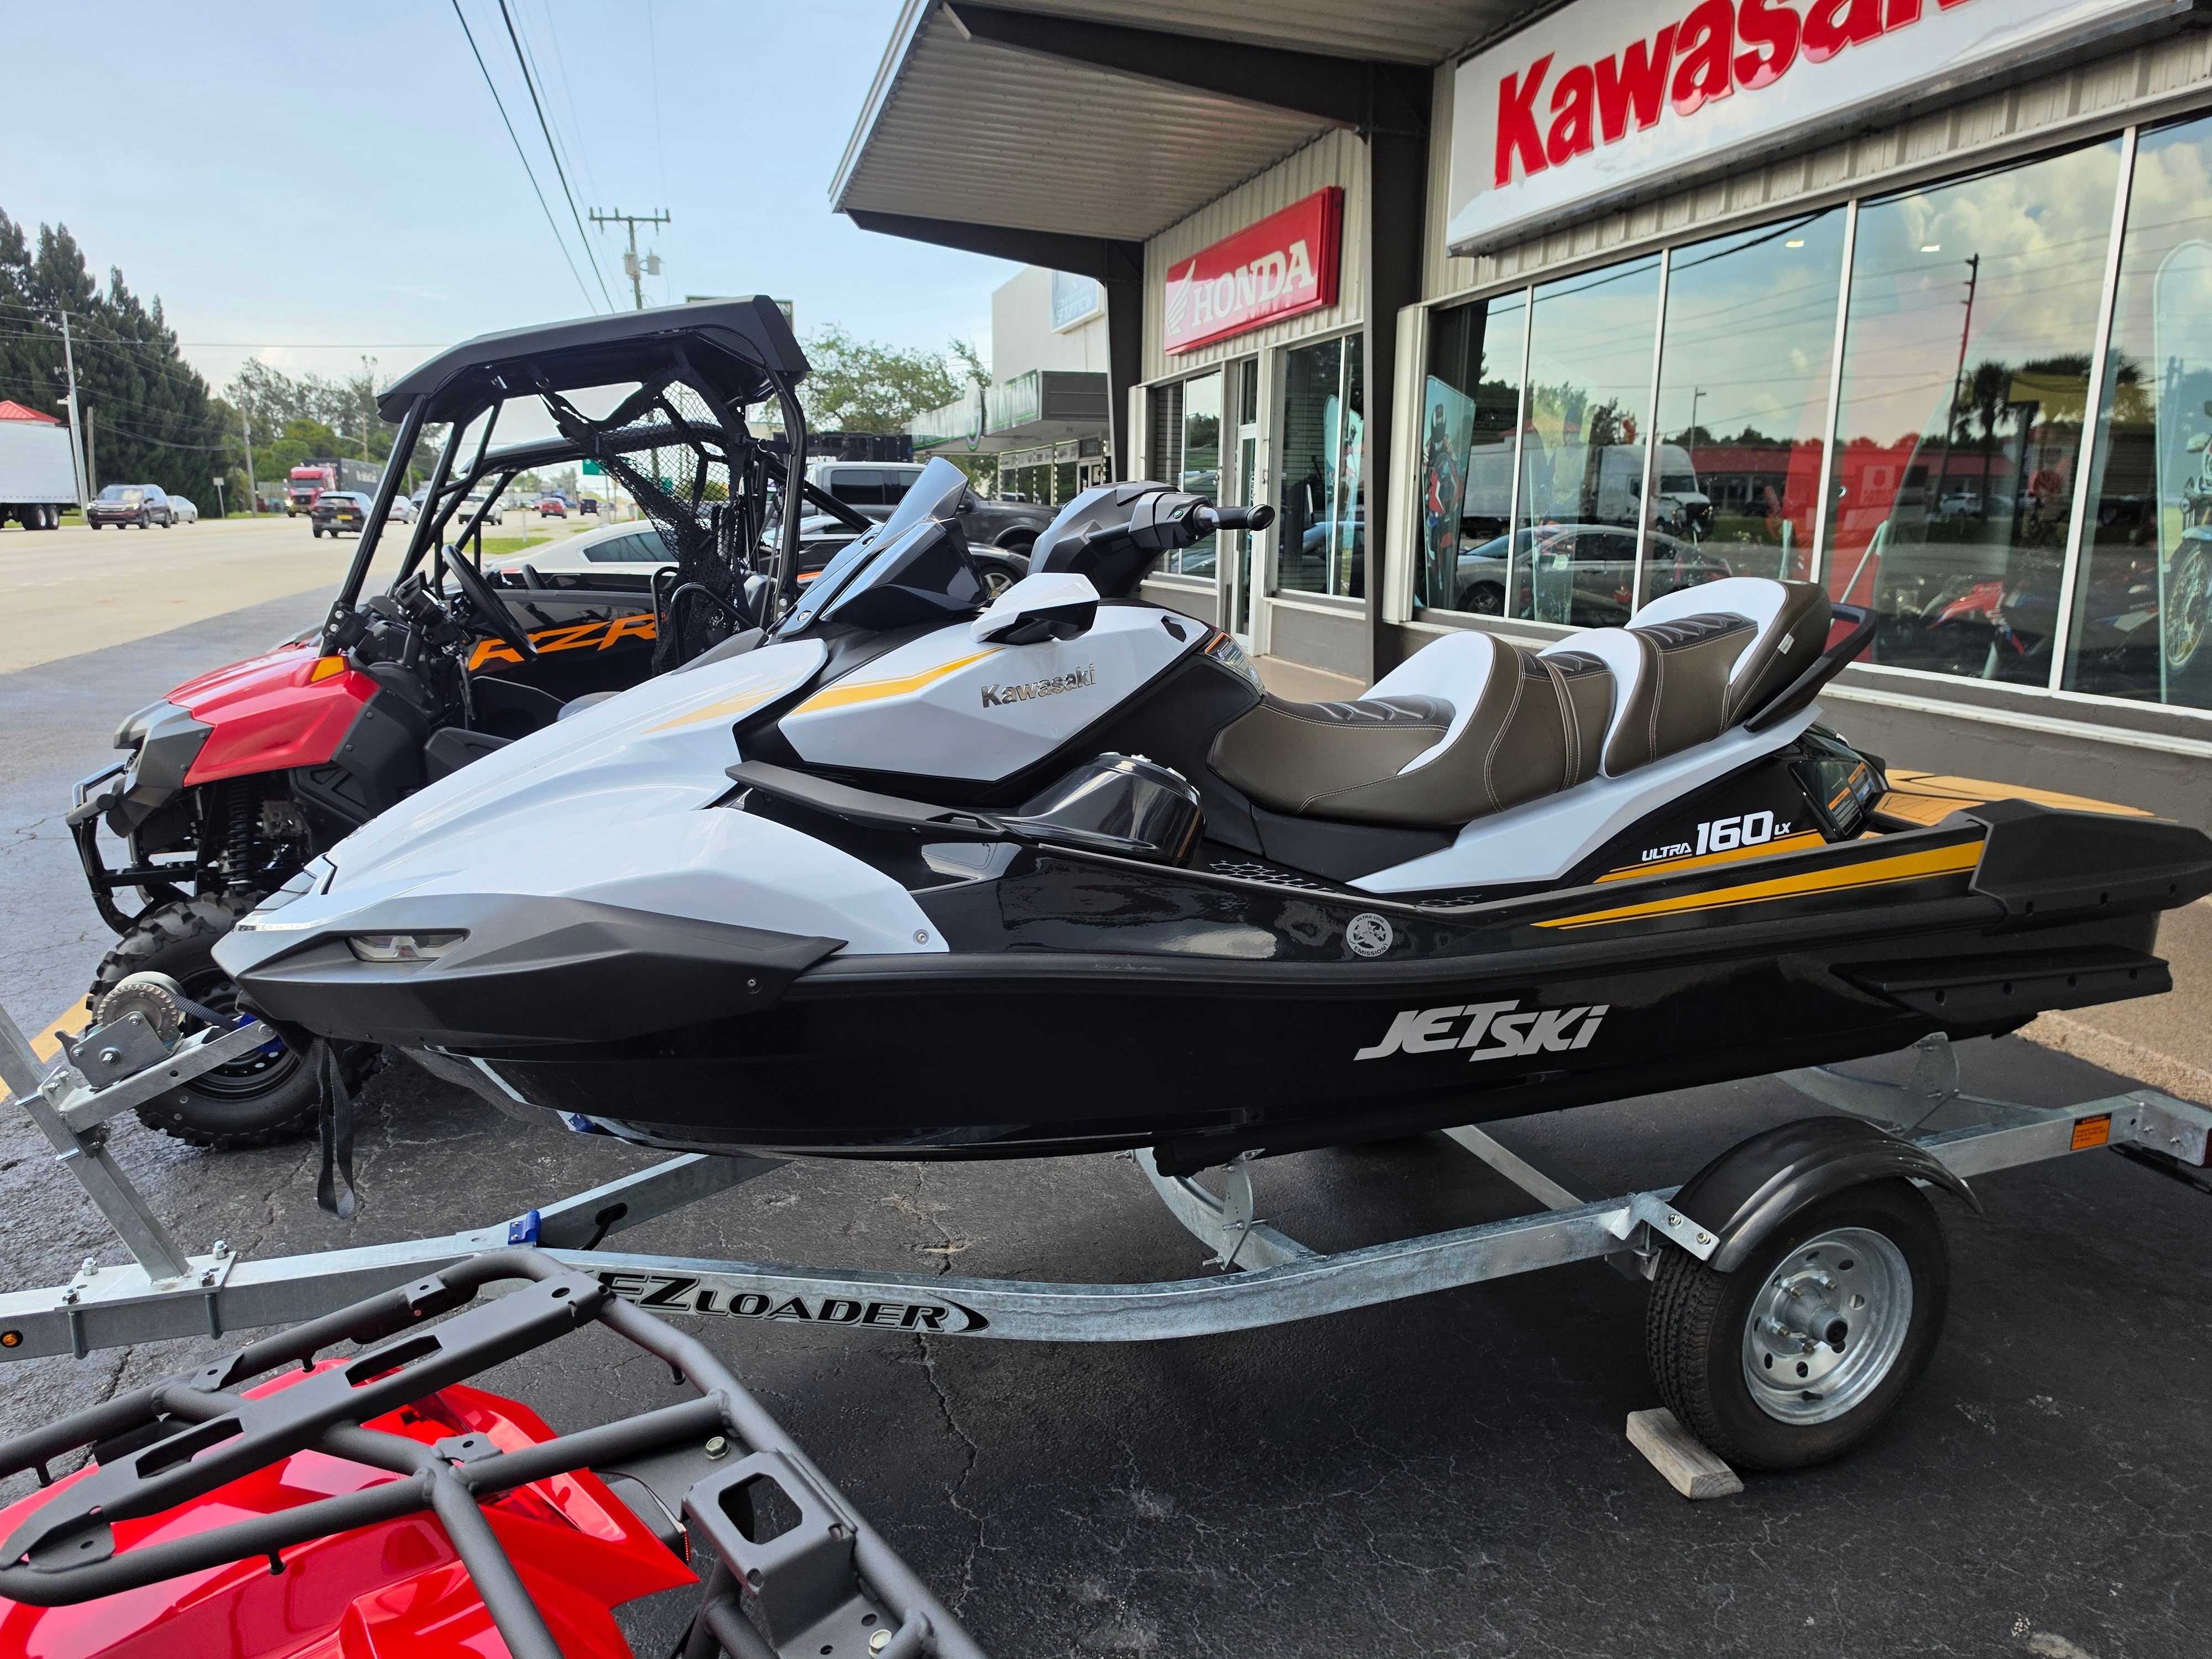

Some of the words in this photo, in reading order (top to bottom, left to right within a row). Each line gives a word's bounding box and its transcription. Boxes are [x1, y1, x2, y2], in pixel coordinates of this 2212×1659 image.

[1192, 239, 1314, 327] HONDA
[981, 664, 1096, 708] Kawasaki
[1641, 843, 1692, 862] ULTRA
[1695, 810, 1774, 855] 160
[1774, 822, 1791, 836] LX
[1356, 915, 1385, 924] ULTRA-LOW
[1354, 946, 1386, 956] EMISSION
